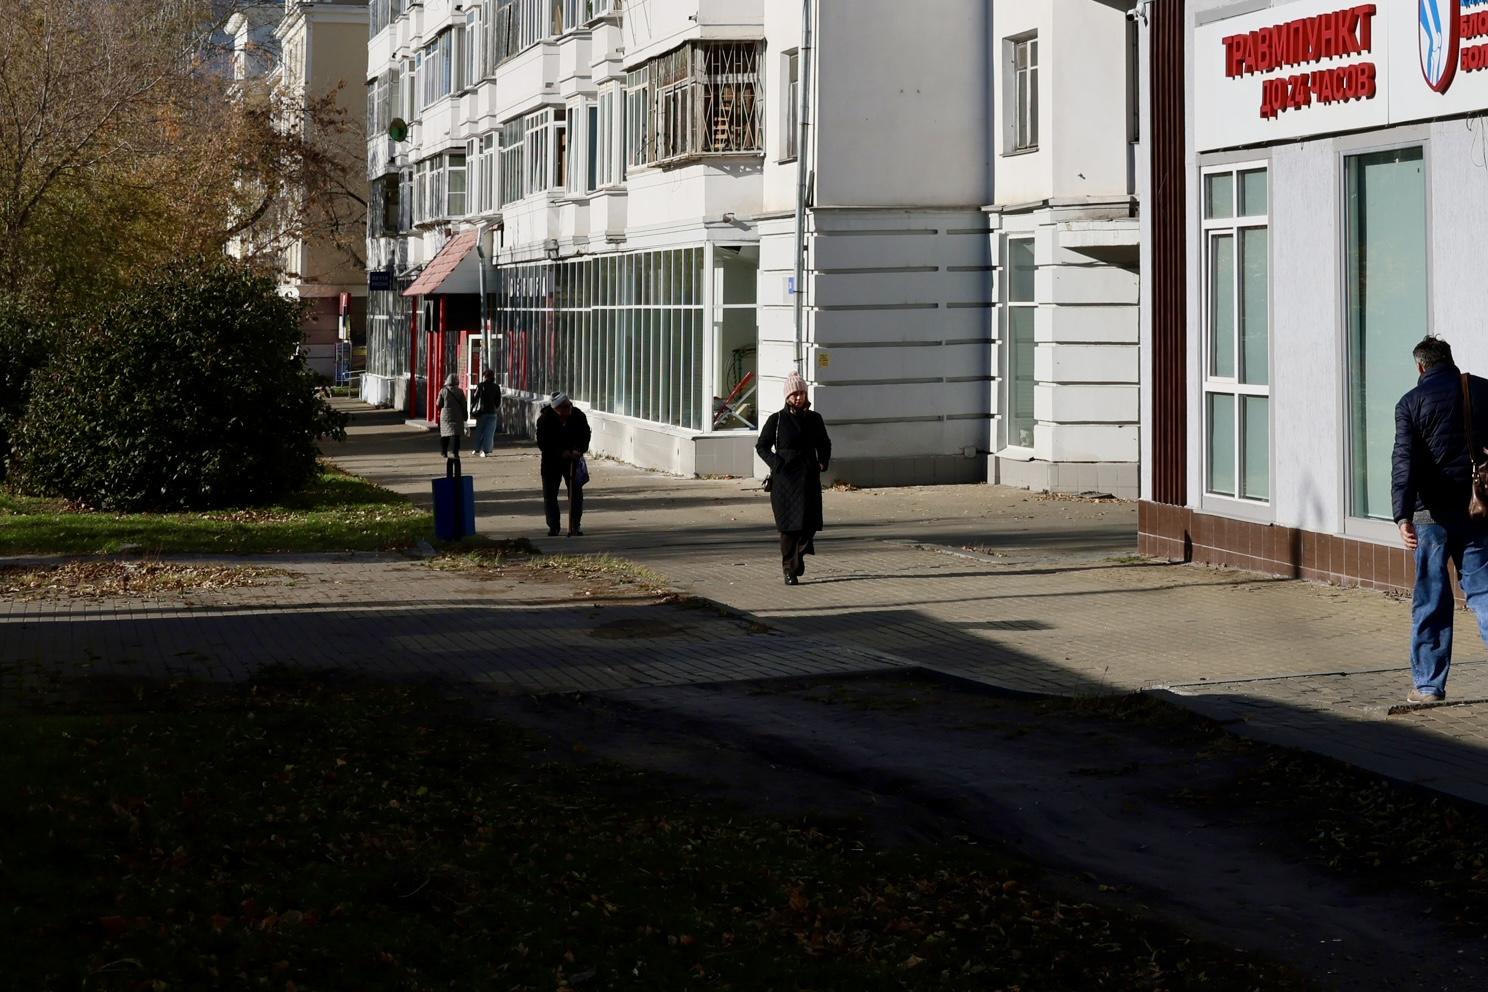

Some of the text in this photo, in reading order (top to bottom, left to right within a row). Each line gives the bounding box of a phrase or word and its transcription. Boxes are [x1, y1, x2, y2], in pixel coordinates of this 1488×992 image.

[1222, 3, 1377, 80] ТРАВМПУНКТ
[1260, 62, 1377, 121] ДО 24 ЧАСОВ
